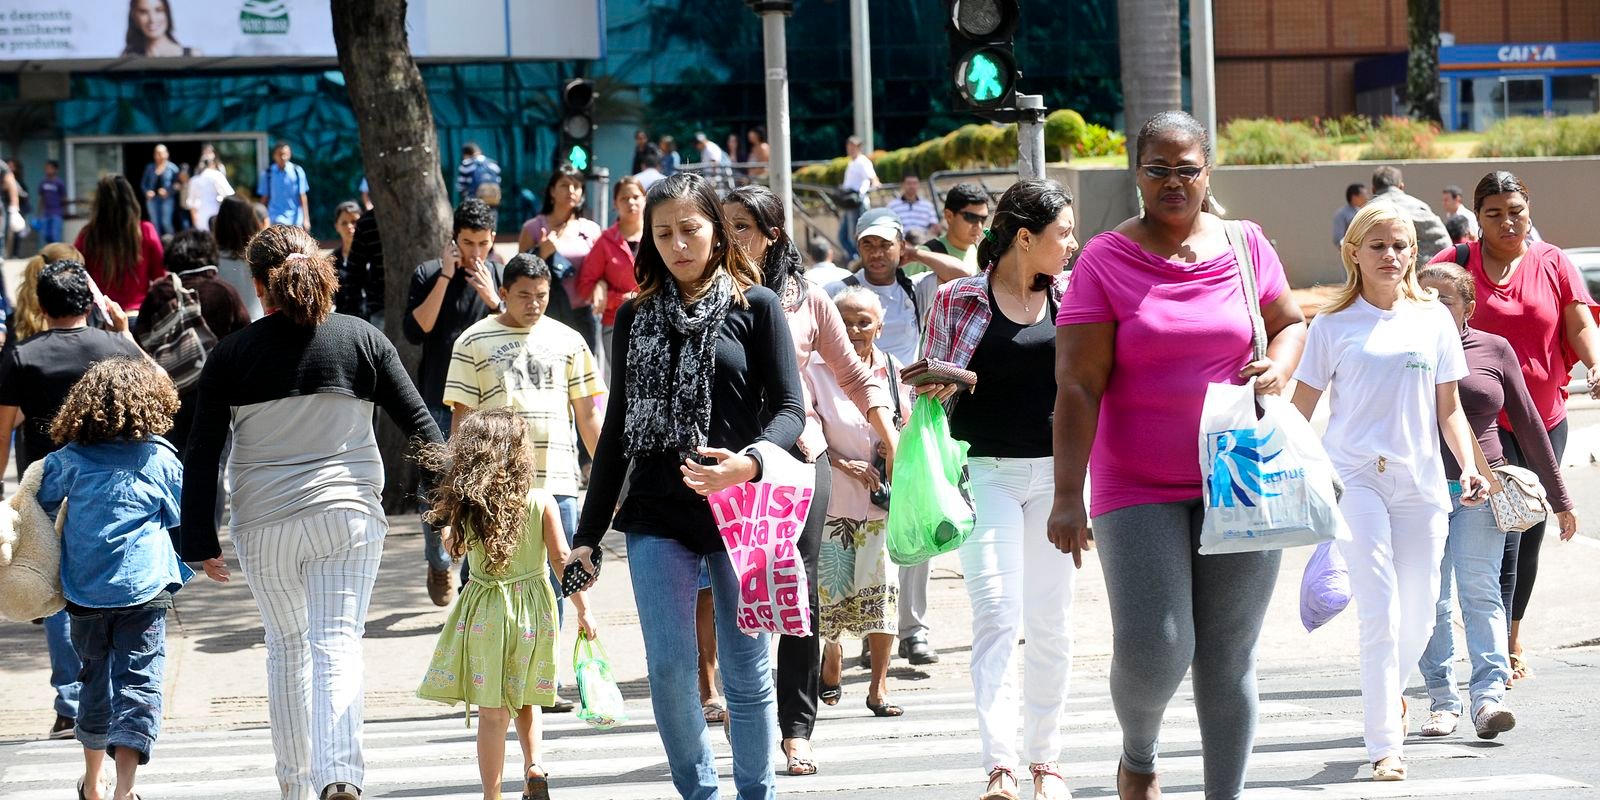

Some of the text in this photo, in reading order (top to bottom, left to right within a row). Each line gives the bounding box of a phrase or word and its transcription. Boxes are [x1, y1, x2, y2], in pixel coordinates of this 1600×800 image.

[10, 9, 72, 20] desconto
[12, 23, 72, 34] milhares
[1498, 45, 1556, 61] CAIXA
